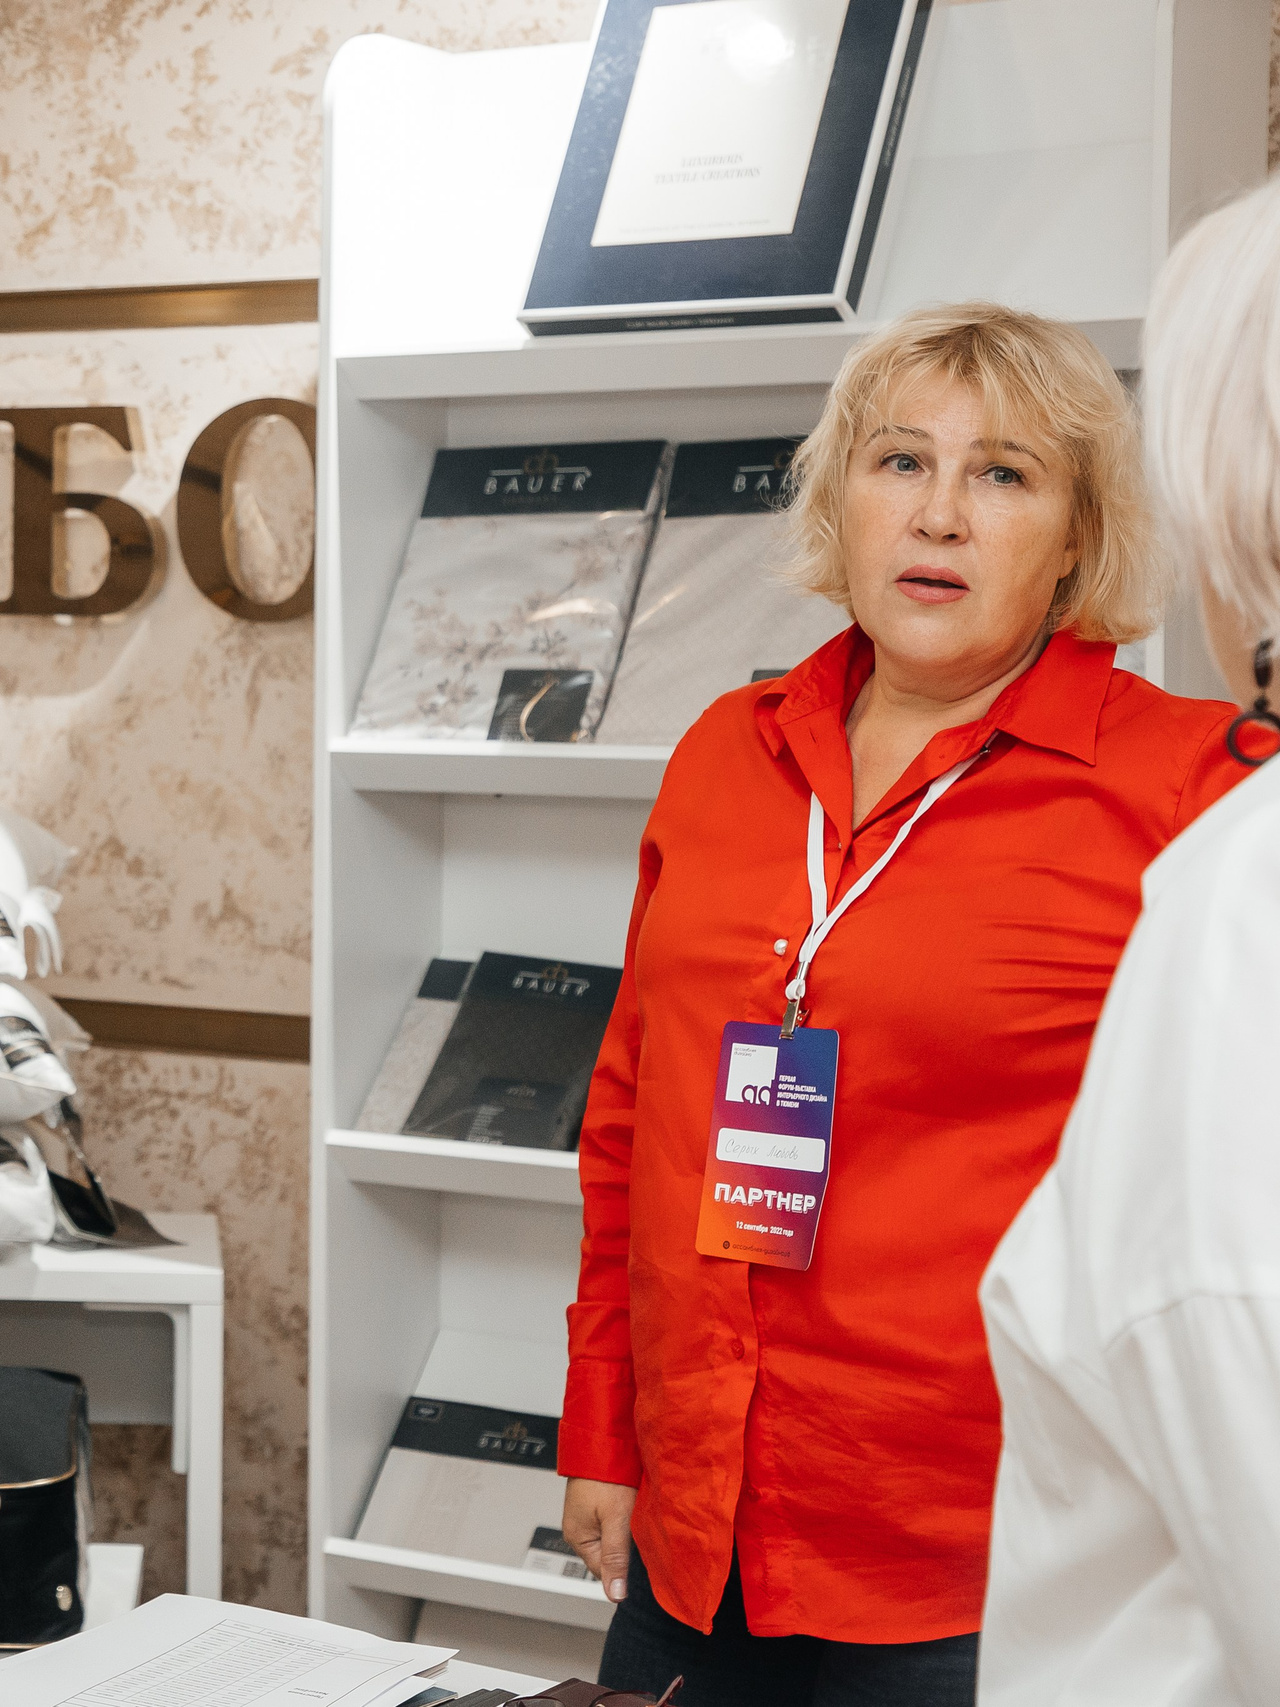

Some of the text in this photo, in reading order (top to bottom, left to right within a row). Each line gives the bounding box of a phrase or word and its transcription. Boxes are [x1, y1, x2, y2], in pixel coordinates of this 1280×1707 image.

[484, 473, 587, 495] BAUER
[714, 1182, 817, 1214] ПАРТНЕР
[736, 1221, 744, 1229] 12
[743, 1223, 768, 1234] сентября
[770, 1226, 783, 1235] 2022
